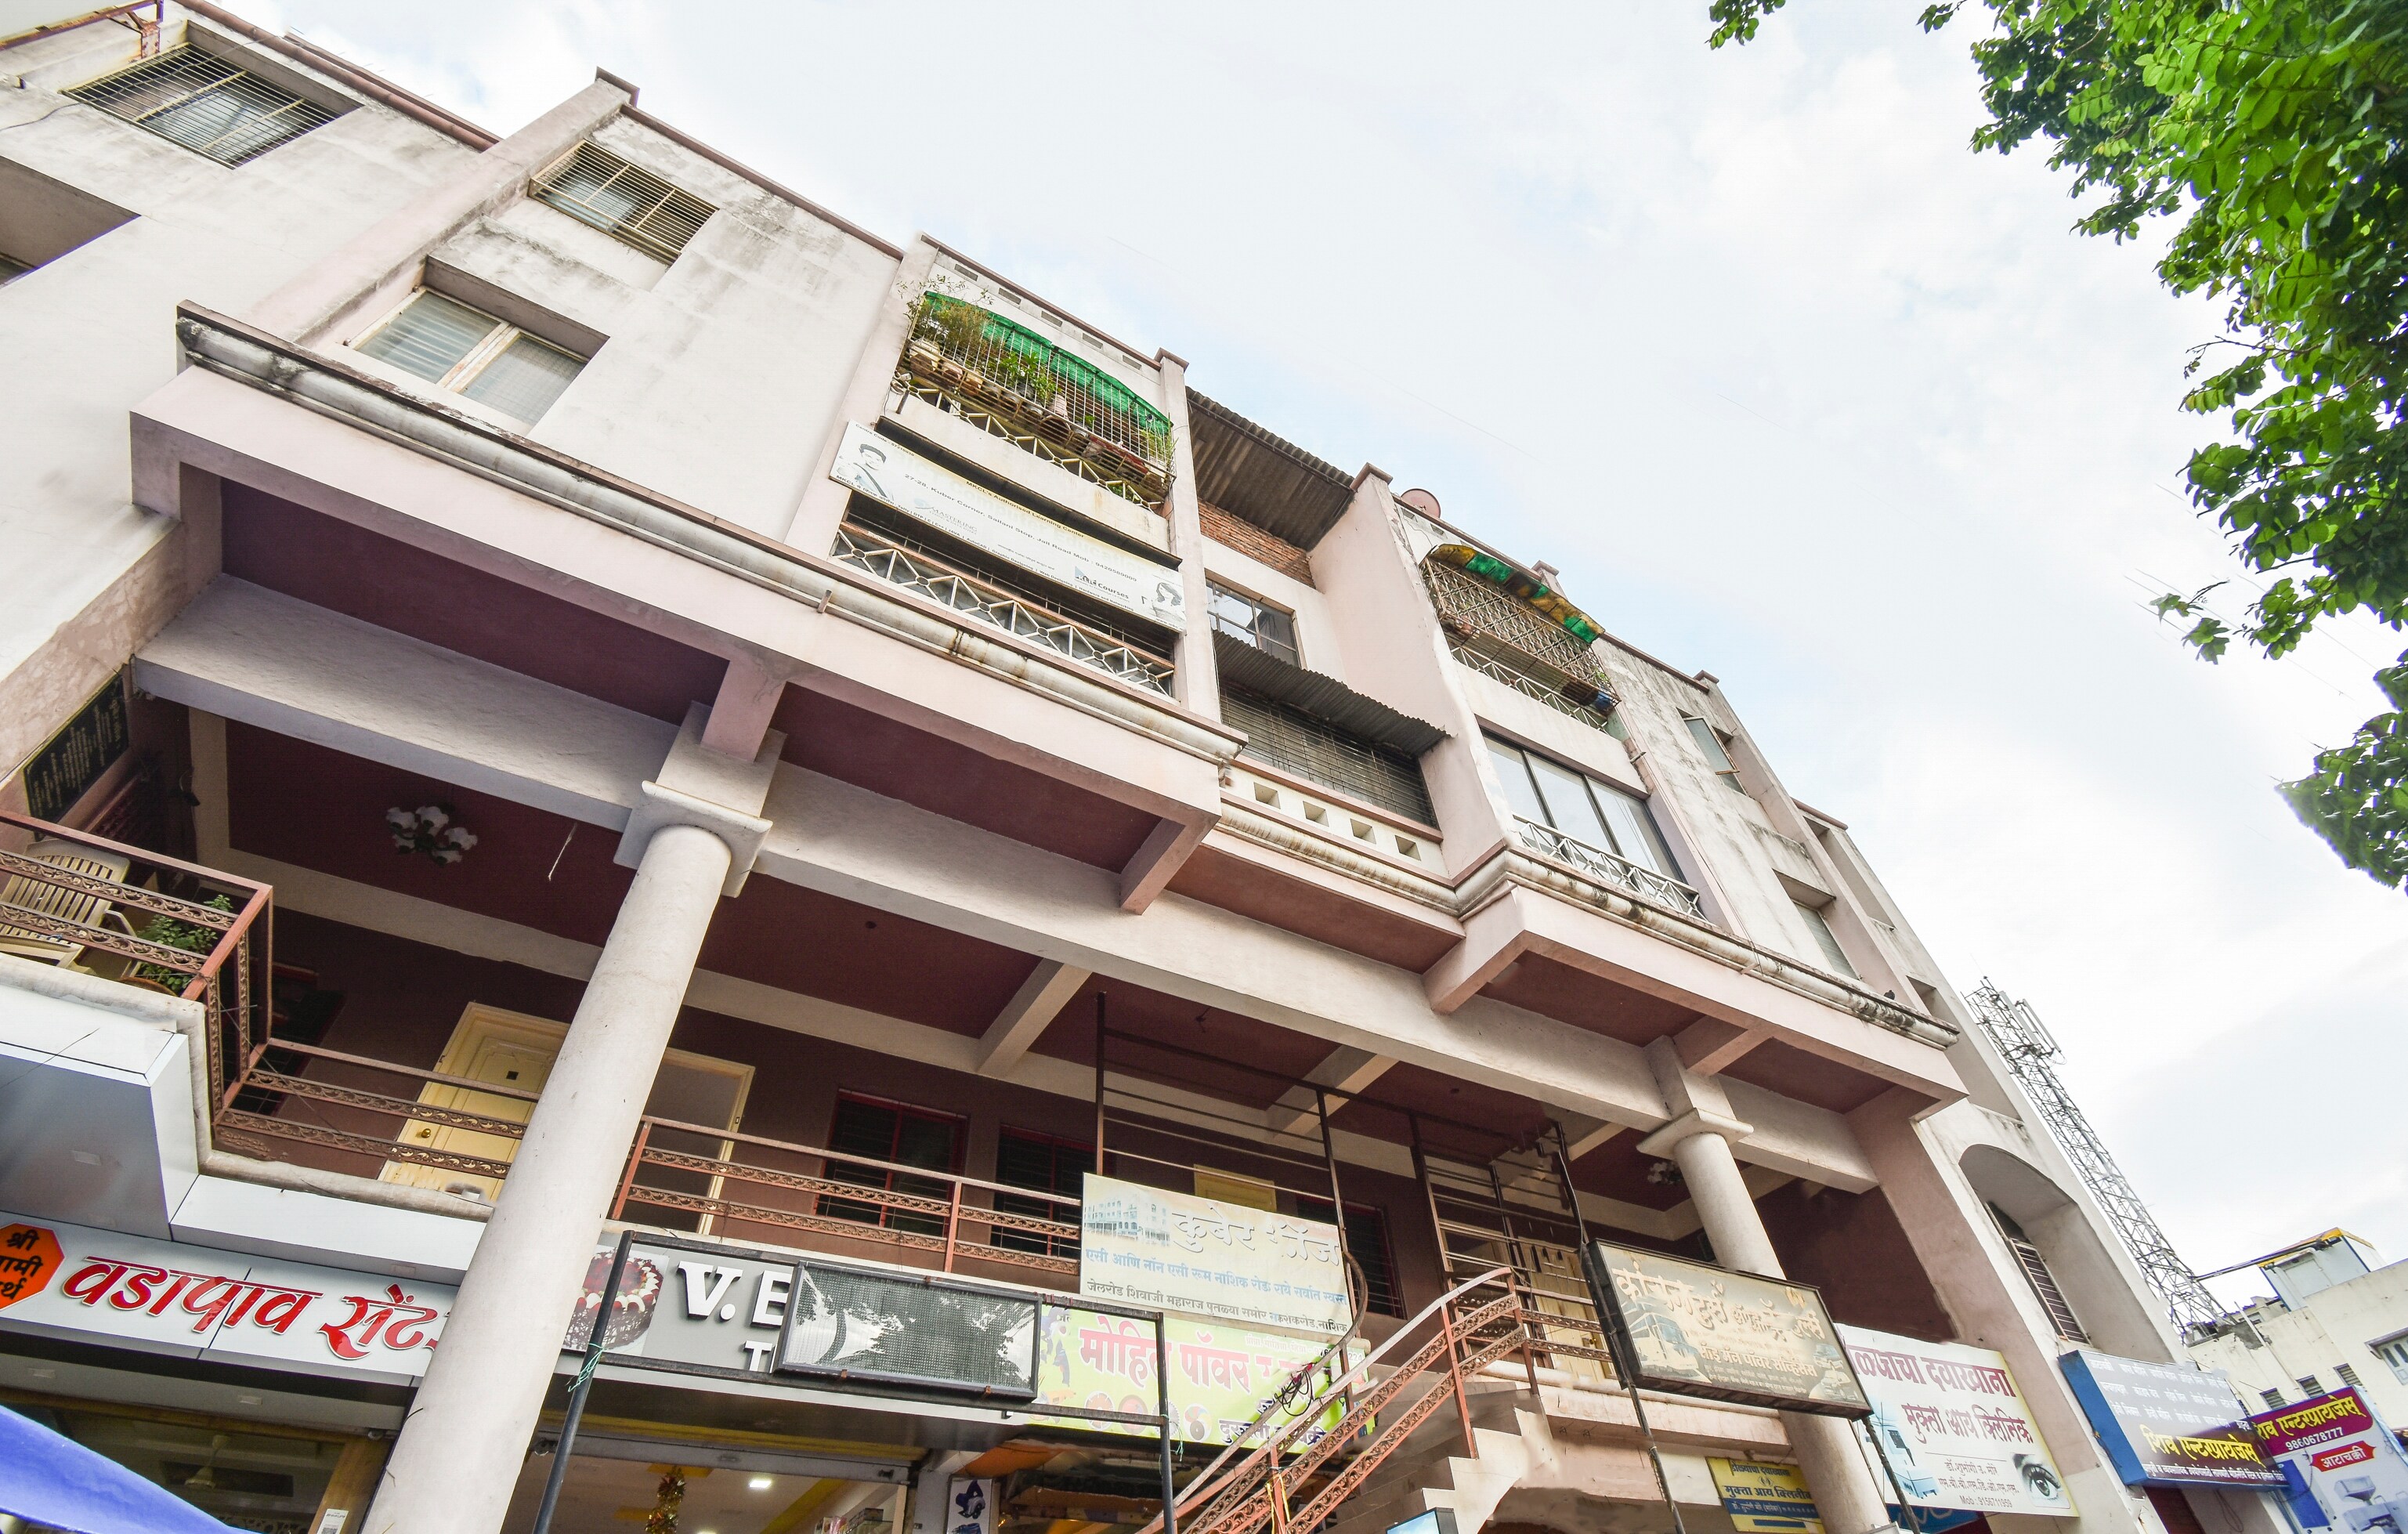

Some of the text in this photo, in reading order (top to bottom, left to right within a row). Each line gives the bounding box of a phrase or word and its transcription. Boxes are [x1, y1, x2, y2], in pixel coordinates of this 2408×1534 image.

[836, 474, 855, 487] MKCL
[948, 527, 960, 537] JAVA
[931, 487, 955, 501] Kuber
[987, 513, 1013, 530] Sailani
[1052, 543, 1071, 556] Road
[1073, 552, 1089, 563] Mob
[965, 480, 1083, 539] MKCL's Authorised Learning Center
[1097, 582, 1128, 599] Courses
[7, 1229, 40, 1250] श्री
[1086, 1249, 1108, 1263] एसी
[1112, 1253, 1141, 1269] आणि
[1143, 1257, 1164, 1274] नॉन
[1167, 1263, 1188, 1279] एसी
[1214, 1271, 1249, 1289] नाशिक
[62, 1254, 450, 1361] वडापाव सेंट
[1087, 1279, 1123, 1297] जेलरोड
[1126, 1286, 1163, 1303] शिवाजी
[1166, 1295, 1203, 1309] महाराज
[1206, 1301, 1239, 1315] पुतळ्या
[1242, 1306, 1267, 1320] समोर
[1179, 1330, 1251, 1394] पॉवर
[1921, 1356, 2016, 1398] दवाखाना
[1901, 1403, 2034, 1445] मुक्ता आय क्लिनिक
[2139, 1424, 2180, 1455] शिव
[2285, 1426, 2345, 1451] 9860678777
[2320, 1446, 2367, 1469] आटाचक्की
[1723, 1485, 1752, 1498] मुक्ता
[1755, 1487, 1774, 1497] आय
[1959, 1496, 1974, 1505] Mob
